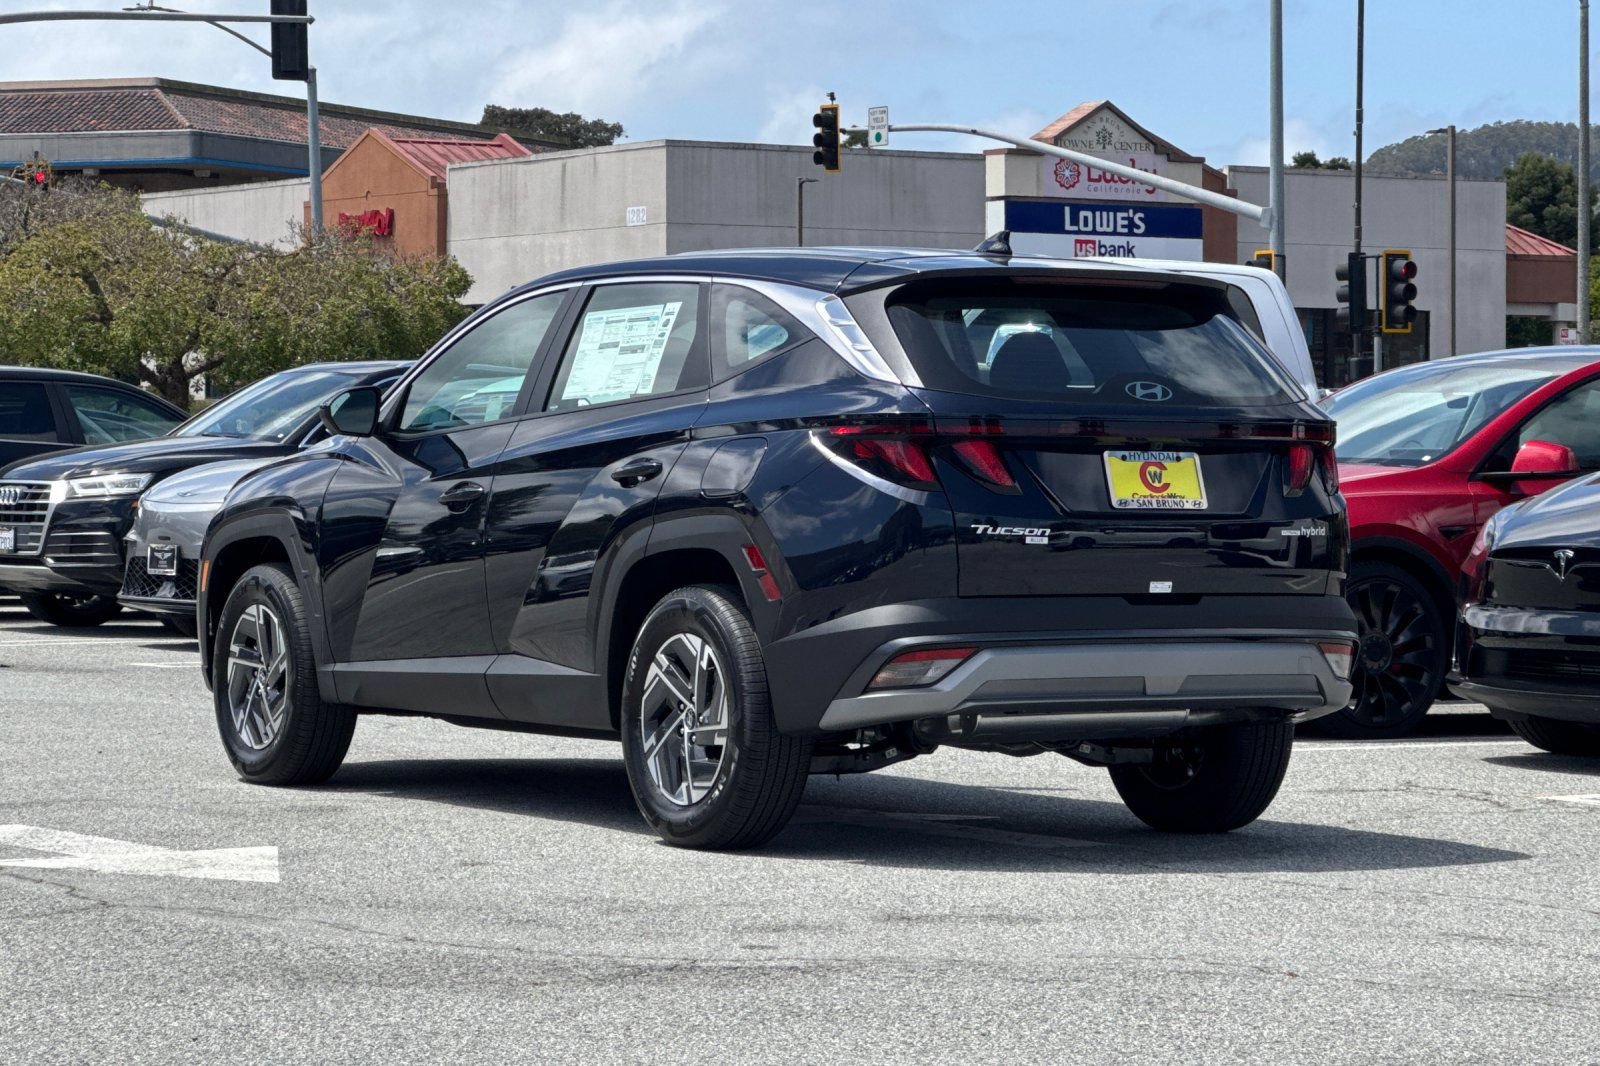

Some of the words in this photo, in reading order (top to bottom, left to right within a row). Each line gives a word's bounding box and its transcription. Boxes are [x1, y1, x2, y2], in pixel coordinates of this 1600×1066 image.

[1114, 142, 1151, 152] CENTER
[1087, 185, 1141, 194] California
[1064, 206, 1146, 234] LOWE'S
[1098, 240, 1136, 258] bank
[1129, 452, 1175, 461] HYUNDAI
[1136, 500, 1153, 508] SAN
[1156, 500, 1185, 508] BRUNO
[1301, 526, 1326, 538] hybrid
